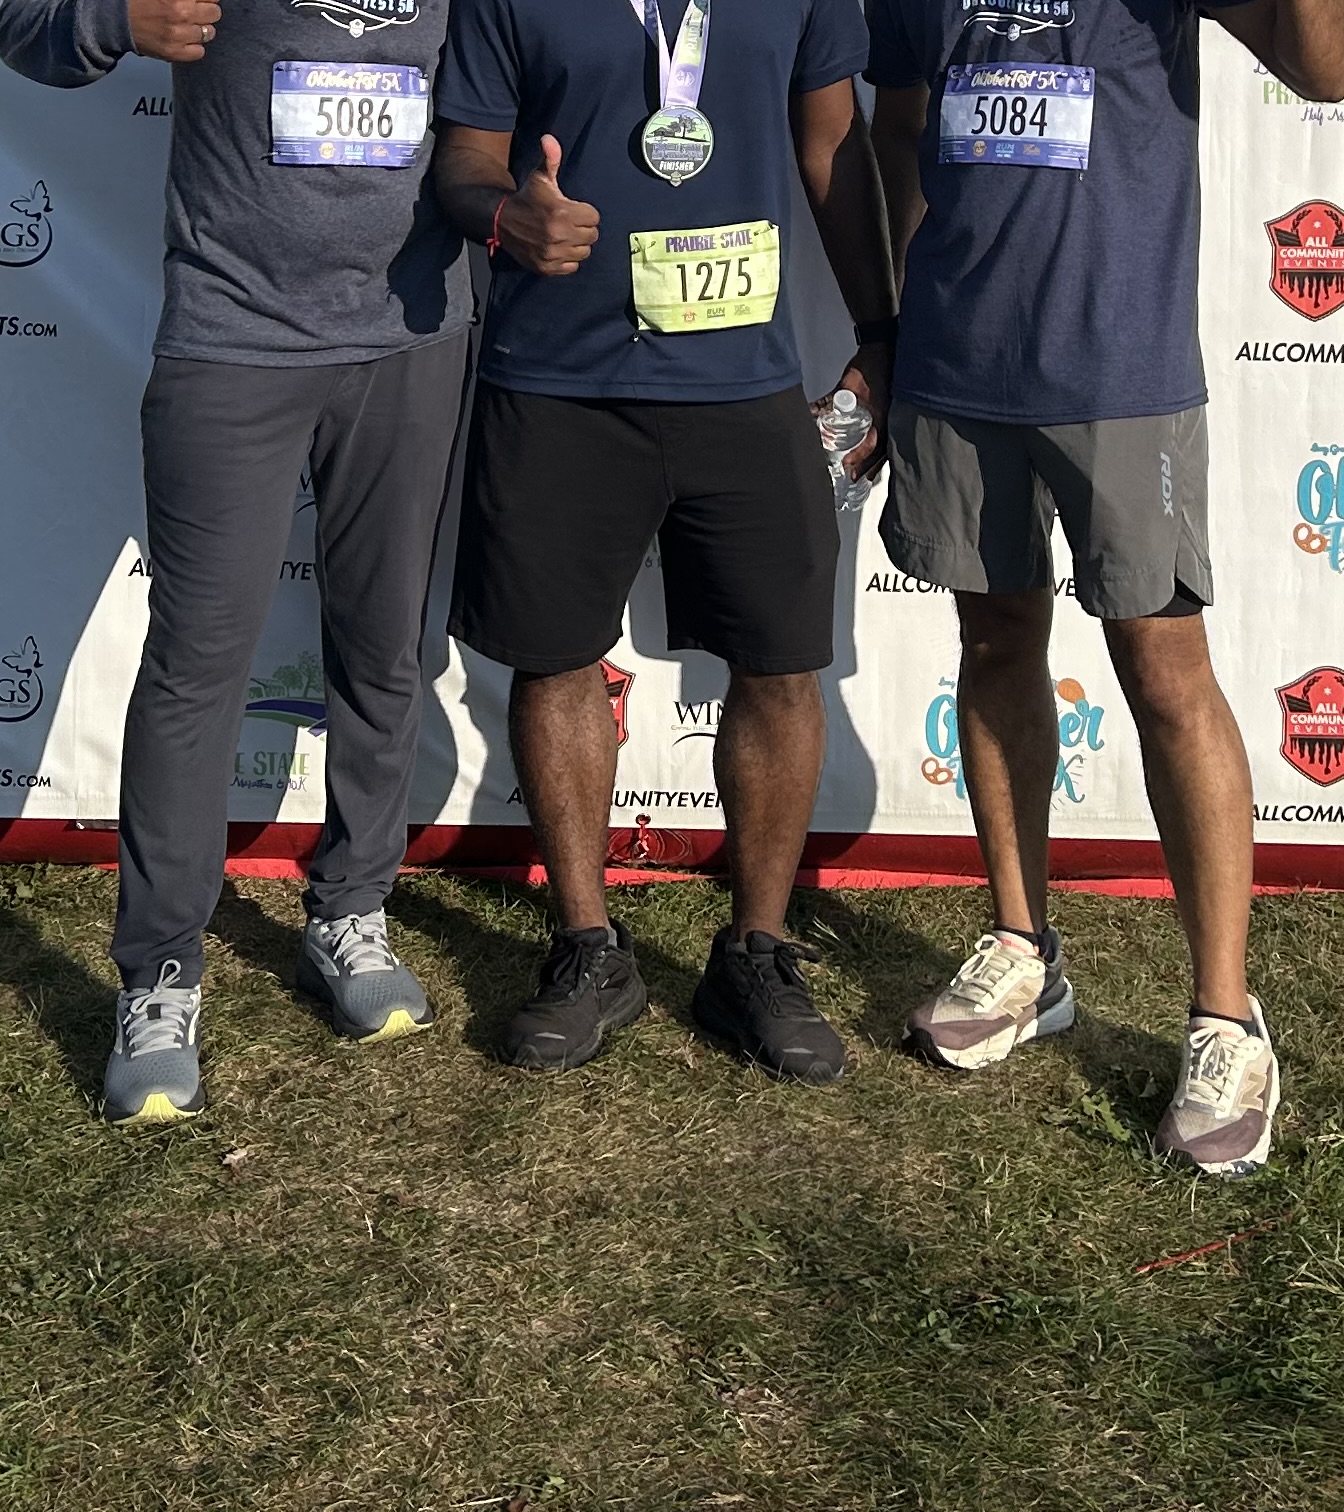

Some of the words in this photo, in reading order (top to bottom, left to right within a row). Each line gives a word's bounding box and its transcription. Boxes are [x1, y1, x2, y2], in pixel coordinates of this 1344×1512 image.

[1036, 71, 1059, 90] 5K
[316, 97, 393, 138] 5086
[971, 96, 1048, 137] 5084
[660, 161, 694, 171] FINISHER
[666, 234, 716, 253] PRAIRIE
[720, 229, 753, 248] STATE
[1305, 236, 1328, 247] ALL
[676, 257, 752, 302] 1275
[1316, 702, 1339, 713] ALL
[253, 751, 310, 776] STATE
